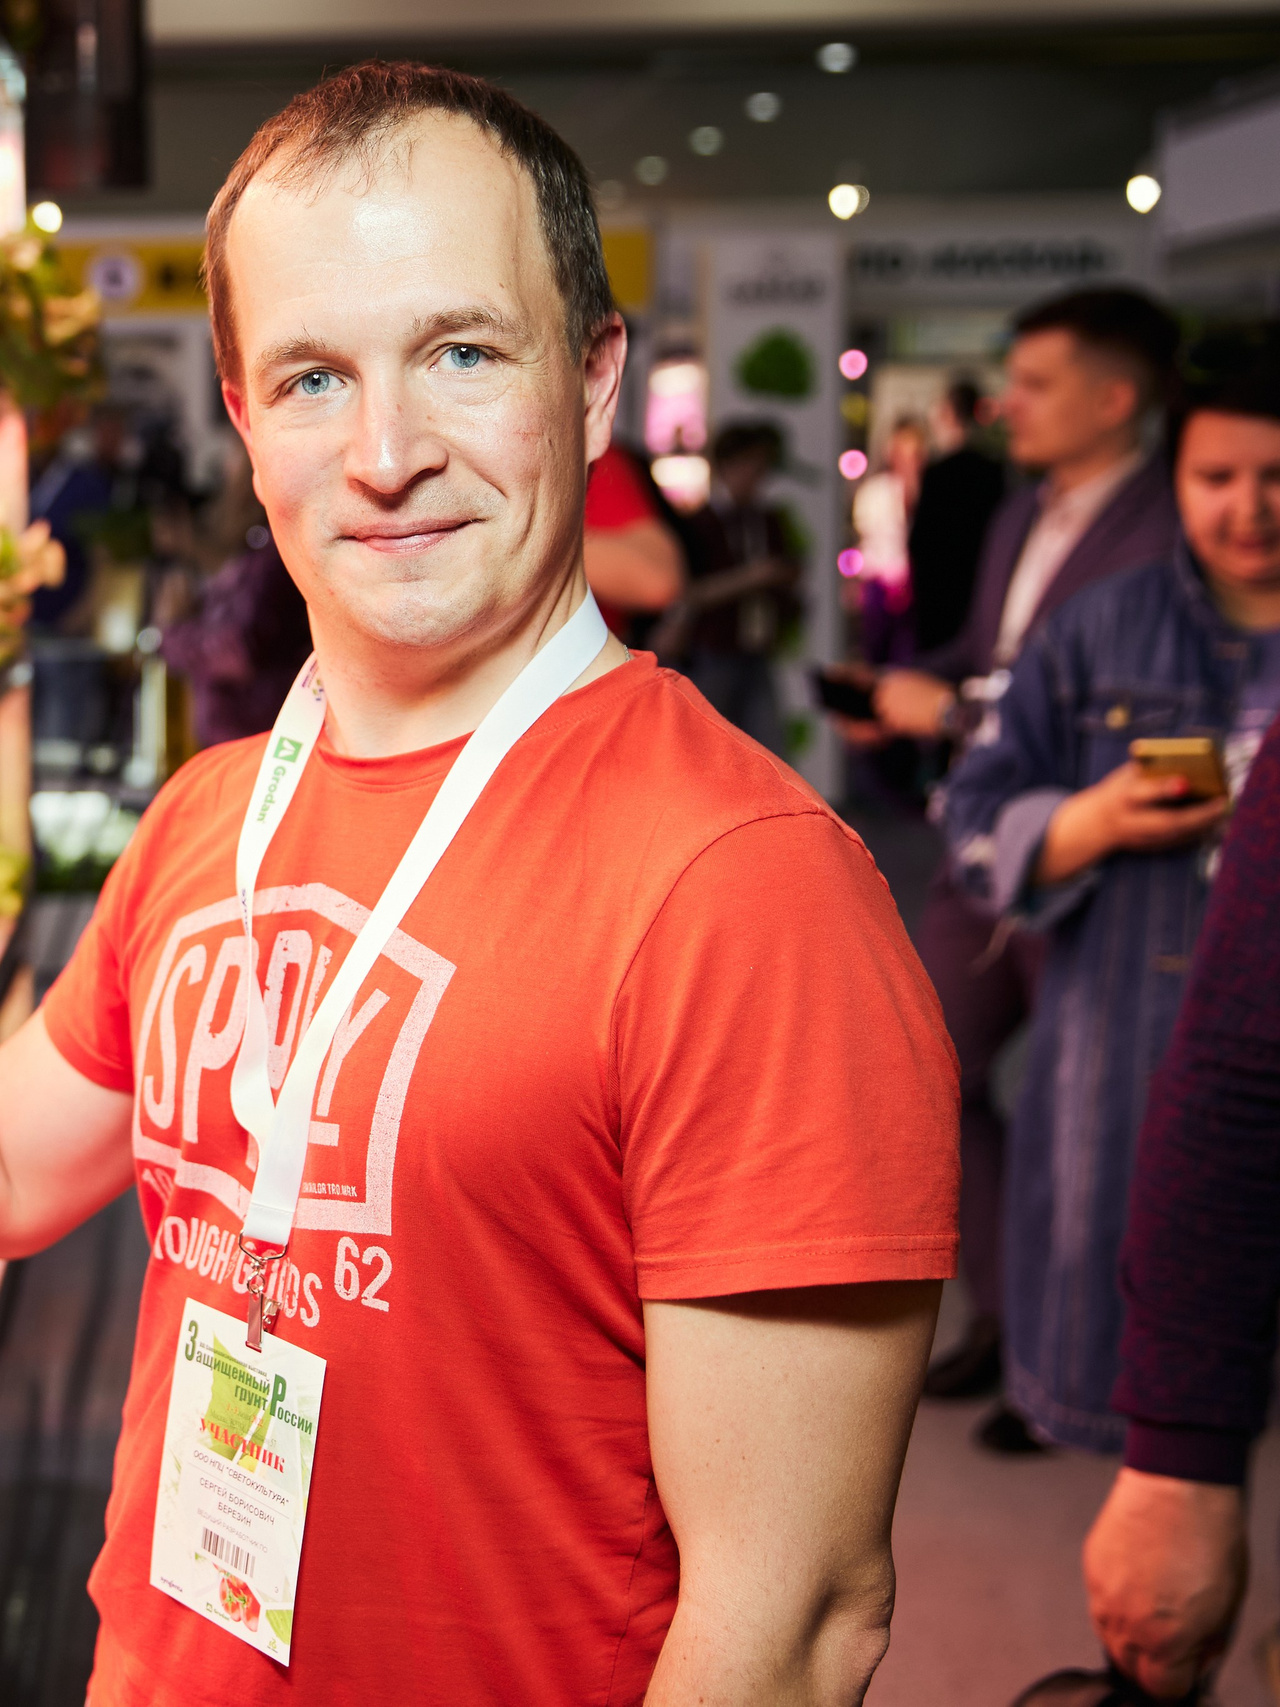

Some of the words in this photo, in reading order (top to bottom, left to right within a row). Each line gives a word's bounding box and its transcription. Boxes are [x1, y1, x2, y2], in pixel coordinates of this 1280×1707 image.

[257, 765, 286, 823] Grodan
[333, 1236, 393, 1313] 62
[185, 1319, 271, 1397] Защищенный
[234, 1384, 268, 1412] грунт
[270, 1373, 313, 1436] России
[193, 1449, 209, 1463] ООО
[210, 1458, 225, 1473] НПЦ
[200, 1417, 286, 1474] УЧАСТНИК
[199, 1477, 227, 1499] СЕРГЕЙ
[228, 1493, 275, 1526] БОРИСОВИЧ
[217, 1501, 252, 1527] БЕРЕЗИН
